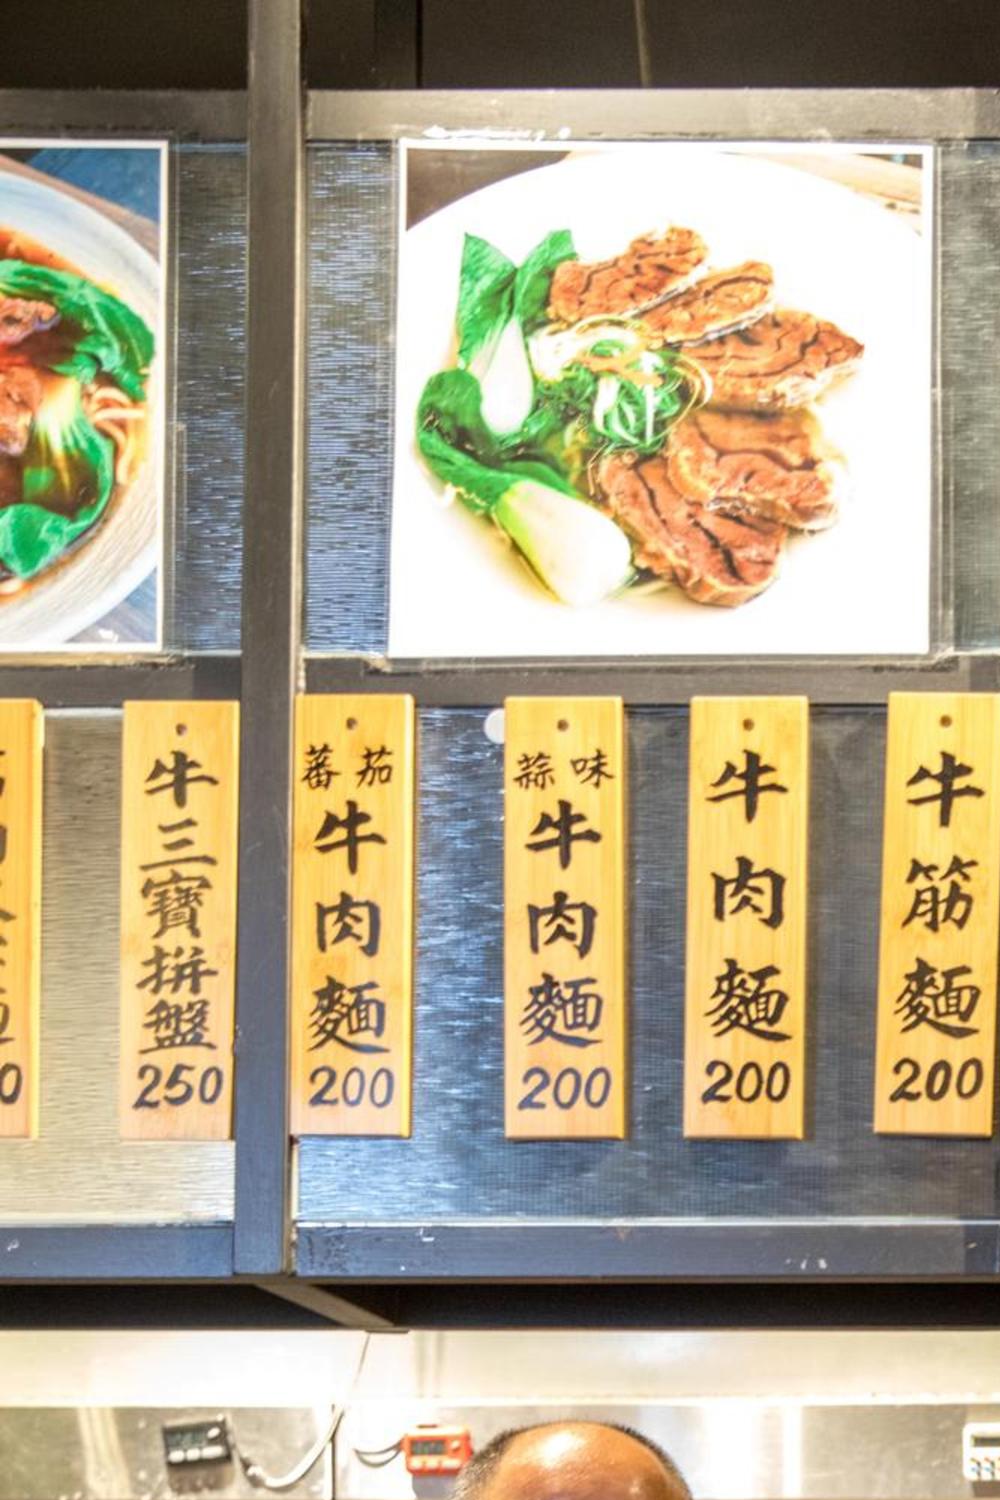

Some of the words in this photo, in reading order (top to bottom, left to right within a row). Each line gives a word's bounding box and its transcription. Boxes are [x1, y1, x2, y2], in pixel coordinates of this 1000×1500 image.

[300, 743, 393, 790] 蕃茄
[513, 748, 615, 790] 蒜味
[705, 749, 792, 1042] 牛肉麵
[895, 751, 984, 1039] 牛筋麵
[308, 800, 391, 1055] 牛肉麵
[520, 799, 603, 1048] 牛肉麵
[134, 1064, 223, 1109] 250
[309, 1066, 394, 1107] 200
[518, 1067, 611, 1110] 200
[701, 1060, 791, 1104] 200
[889, 1057, 983, 1103] 200
